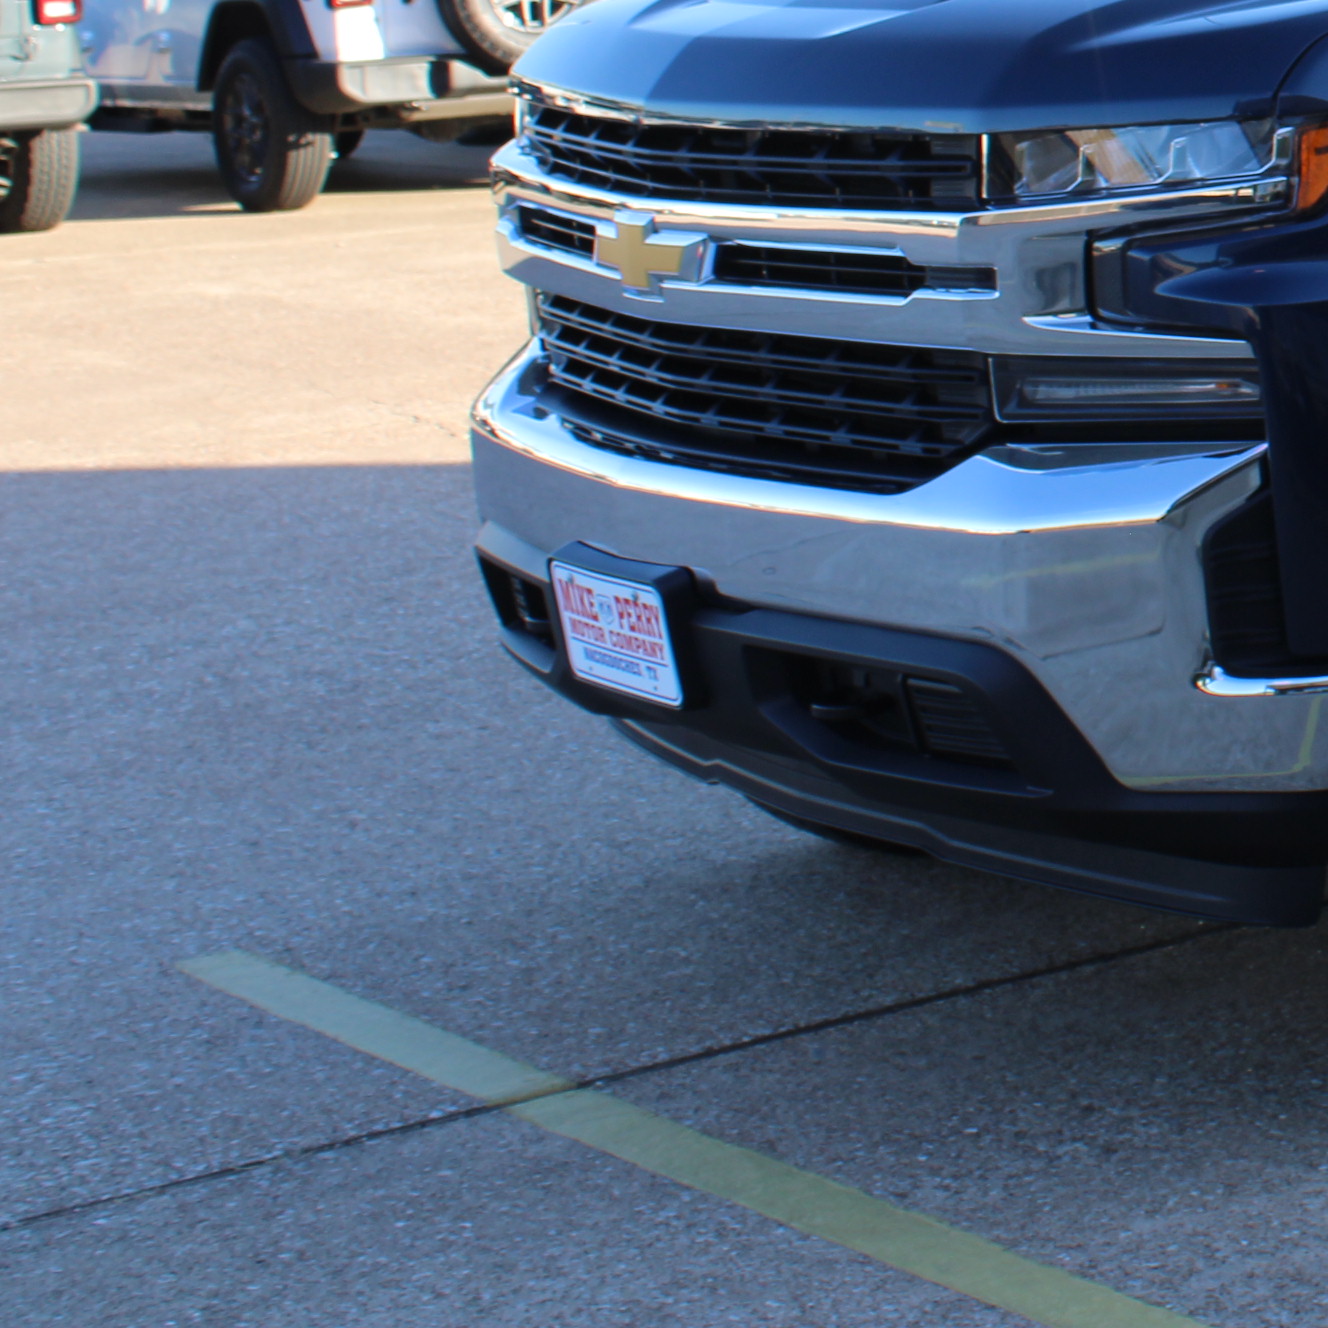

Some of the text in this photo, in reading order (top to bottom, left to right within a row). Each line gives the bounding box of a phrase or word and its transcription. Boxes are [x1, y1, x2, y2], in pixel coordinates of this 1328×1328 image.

[558, 578, 664, 641] MIKE PERRY
[568, 616, 665, 661] MOTOR COMPANY
